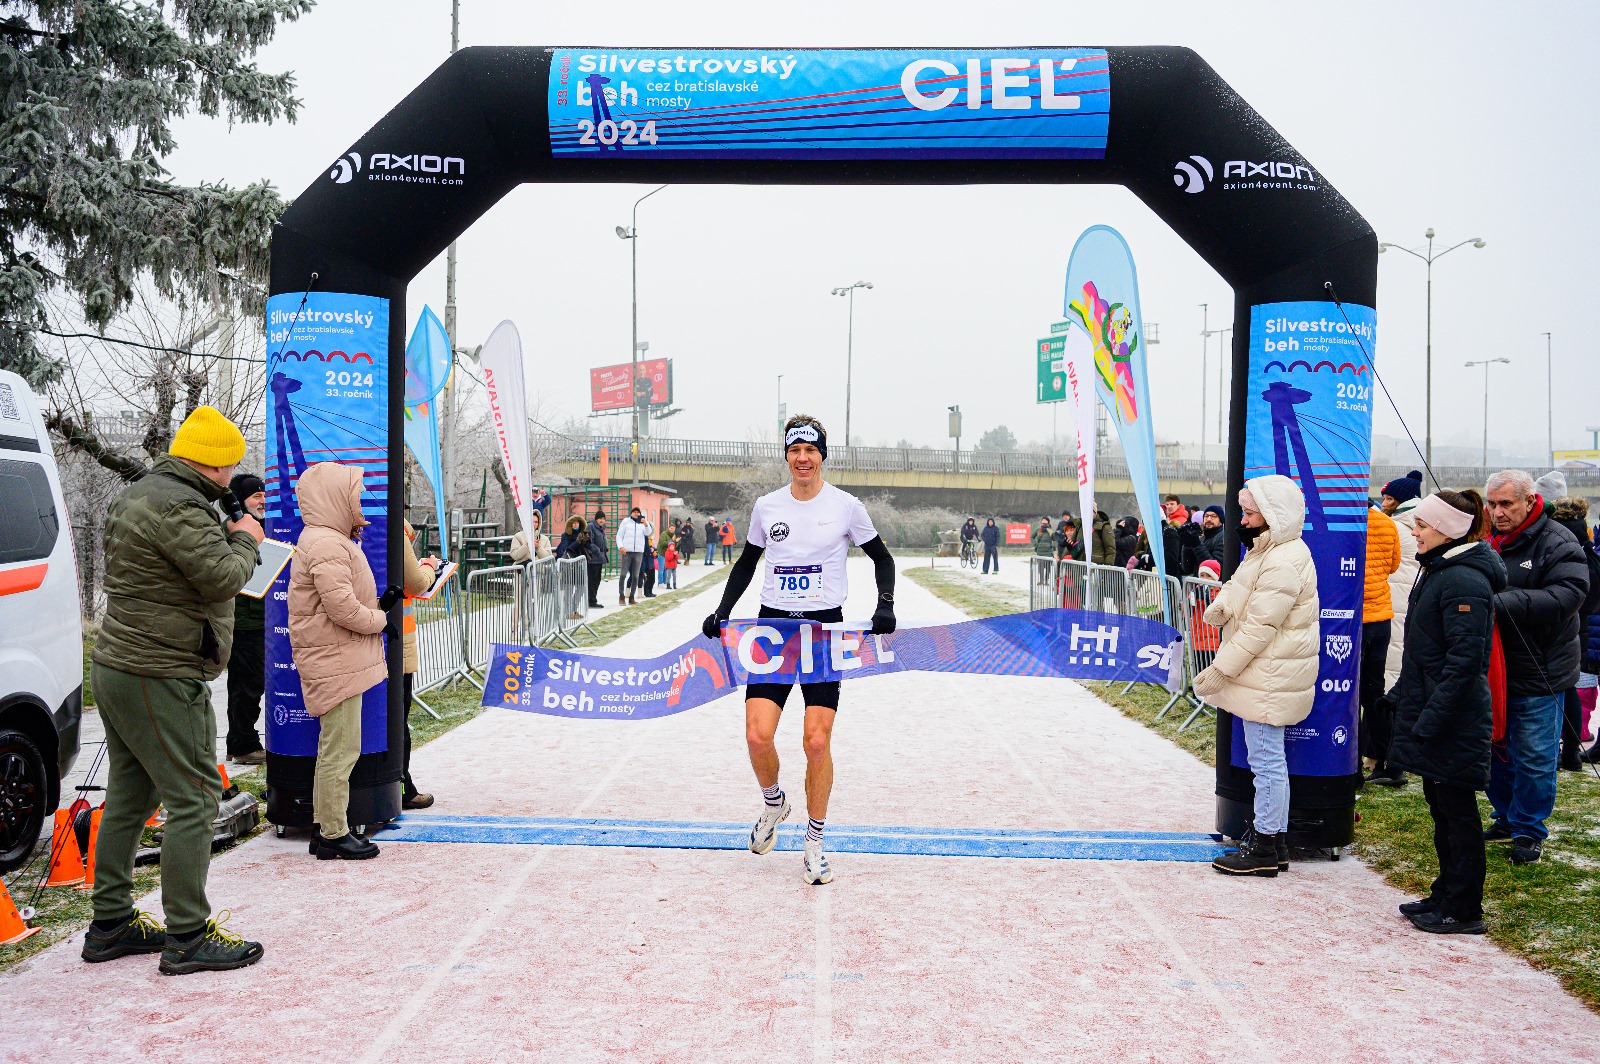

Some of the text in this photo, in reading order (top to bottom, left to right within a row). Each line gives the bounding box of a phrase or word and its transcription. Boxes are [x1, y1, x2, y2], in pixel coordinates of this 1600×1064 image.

[577, 54, 798, 80] Silvestrovský
[646, 79, 759, 92] cez bratislavské
[900, 58, 1081, 111] CIEĽ
[576, 80, 638, 107] beh
[646, 95, 692, 110] mosty
[577, 119, 658, 145] 2024
[368, 173, 464, 186] axion4event.com
[1223, 181, 1316, 191] axion4event.com
[270, 308, 374, 328] Silvestrovský
[270, 328, 290, 344] beh
[307, 326, 354, 334] bratislavské
[1265, 318, 1372, 340] Silvestrovský
[1264, 337, 1299, 352] beh
[1304, 344, 1330, 353] mosty
[326, 370, 374, 388] 2024
[326, 388, 372, 398] 33. ročník
[1336, 382, 1369, 400] 2024
[1336, 401, 1349, 409] 33.
[779, 576, 810, 590] 780
[546, 648, 697, 688] Silvestrovský
[503, 651, 523, 704] 2024
[522, 653, 536, 705] 33. ročník
[1322, 679, 1350, 692] OLO
[542, 687, 594, 712] beh
[601, 685, 680, 702] cez bratislavské
[600, 704, 636, 716] mosty
